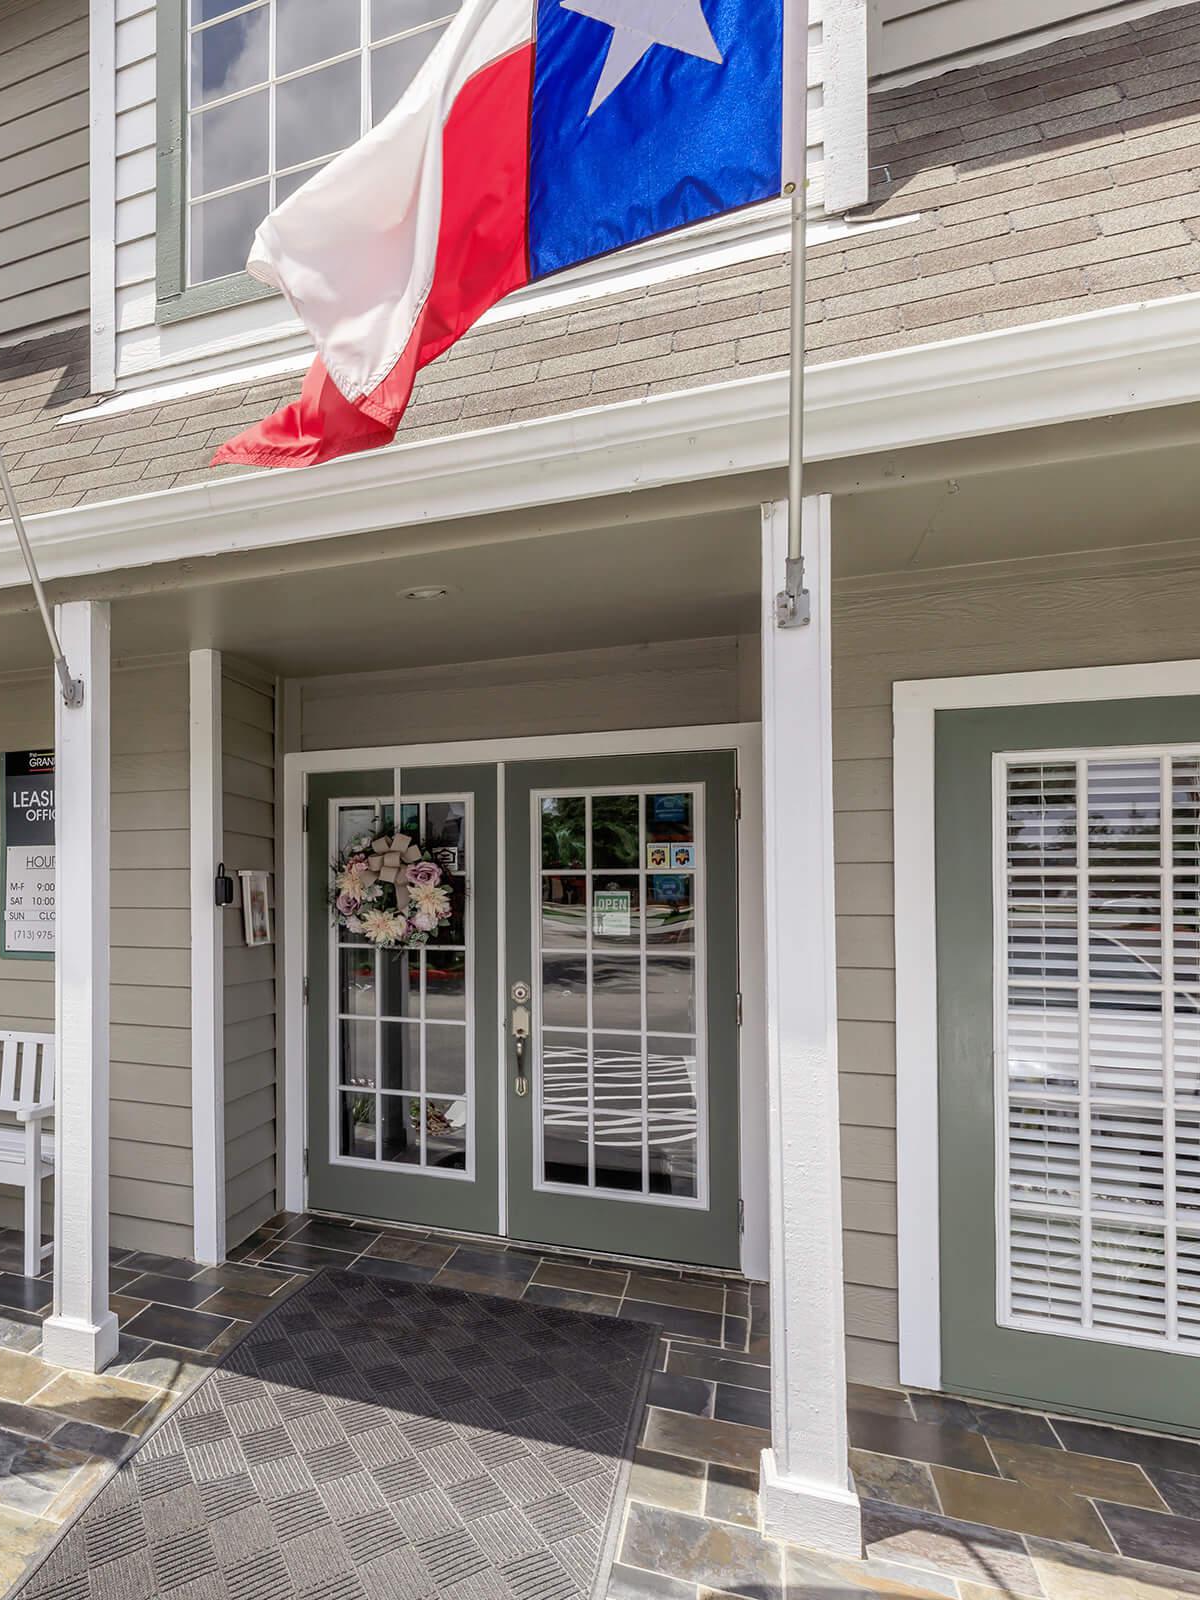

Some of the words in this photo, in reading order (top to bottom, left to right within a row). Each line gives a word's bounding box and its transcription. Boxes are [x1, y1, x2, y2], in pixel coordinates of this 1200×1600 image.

[10, 882, 25, 891] M-F
[36, 882, 56, 892] 9:00
[10, 896, 23, 906] SAT
[32, 896, 55, 906] 10:00
[598, 898, 627, 910] OPEN
[9, 911, 25, 920] SUN
[14, 929, 35, 941] (713)
